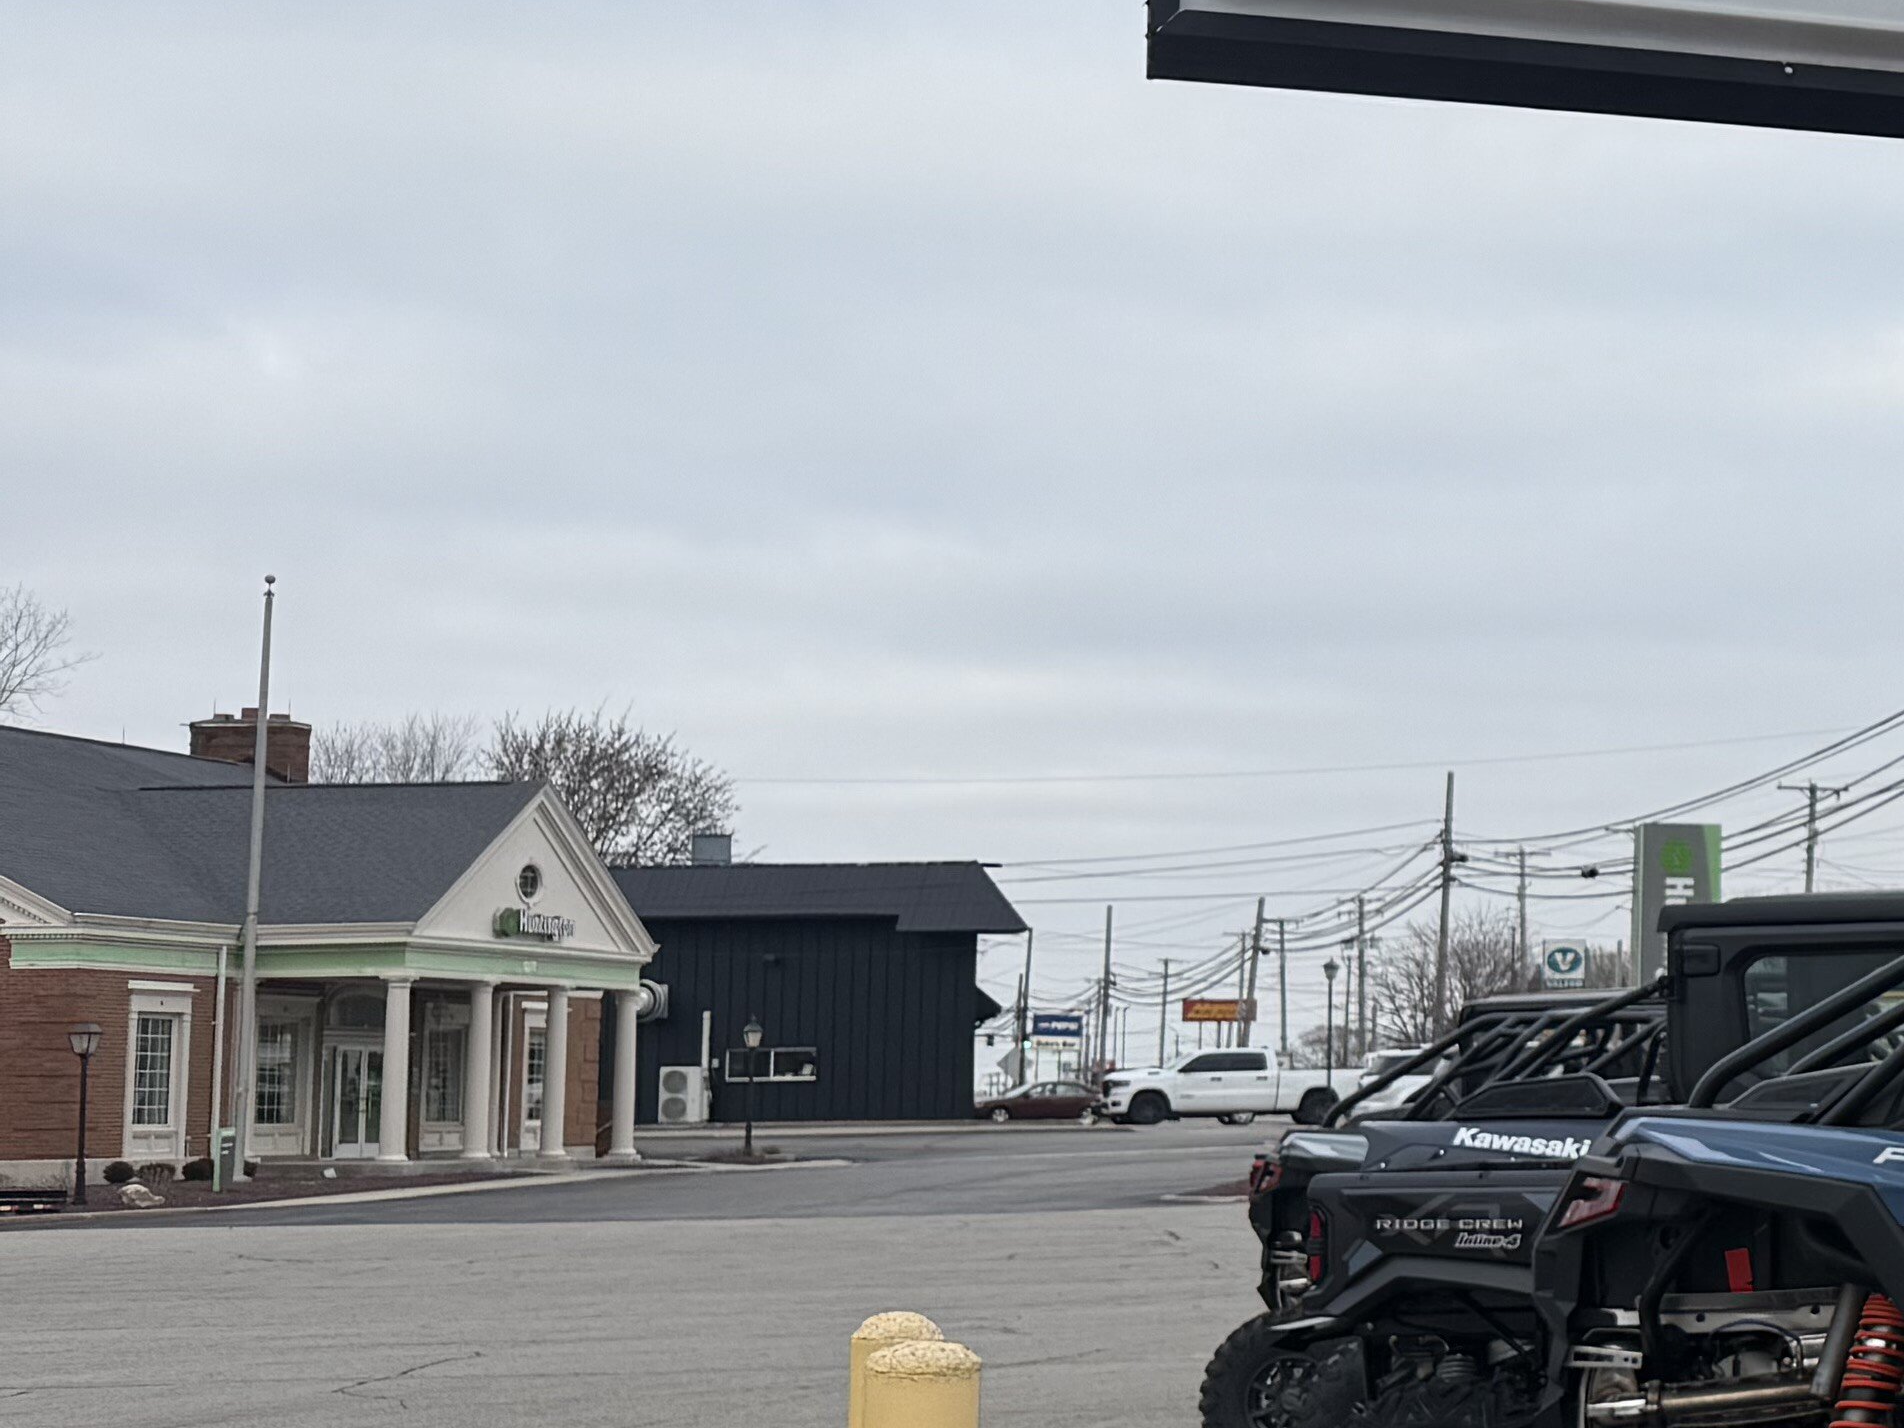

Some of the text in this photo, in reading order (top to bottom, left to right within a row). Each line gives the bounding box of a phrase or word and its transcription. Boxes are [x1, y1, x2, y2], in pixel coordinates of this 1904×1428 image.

[1453, 1127, 1592, 1159] Kawasaki
[1376, 1218, 1523, 1230] RIDGE CREW
